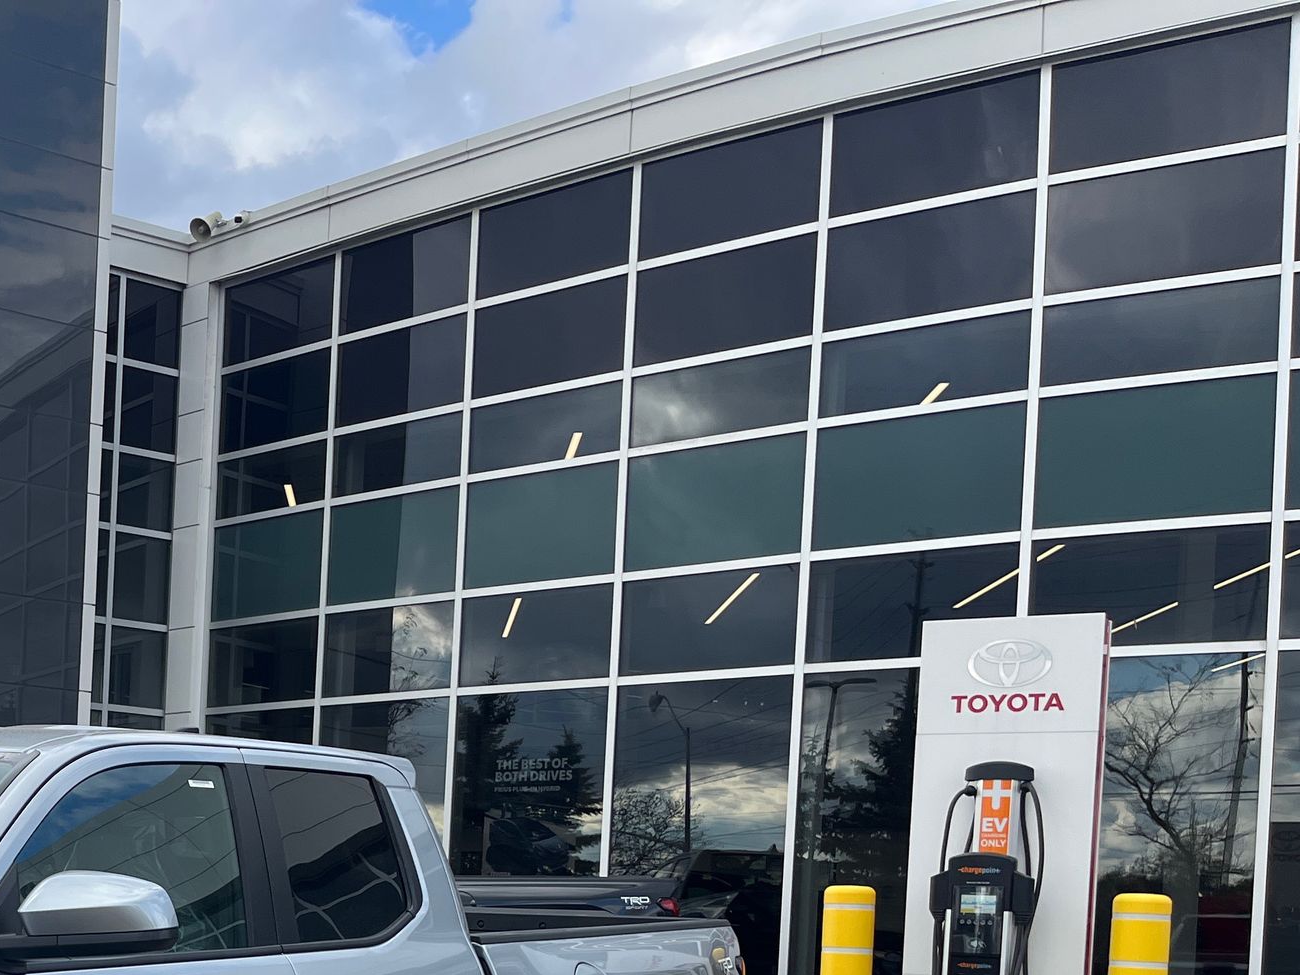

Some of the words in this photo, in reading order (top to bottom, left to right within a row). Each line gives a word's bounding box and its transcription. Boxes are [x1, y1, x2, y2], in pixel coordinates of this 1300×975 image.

[951, 692, 1064, 714] TOYOTA
[496, 759, 519, 770] THE
[521, 758, 550, 769] BEST
[552, 757, 568, 768] OF
[495, 771, 528, 782] BOTH
[530, 769, 573, 781] DRIVES
[981, 817, 1008, 833] EV
[981, 838, 1006, 847] ONLY
[620, 896, 650, 905] TRD
